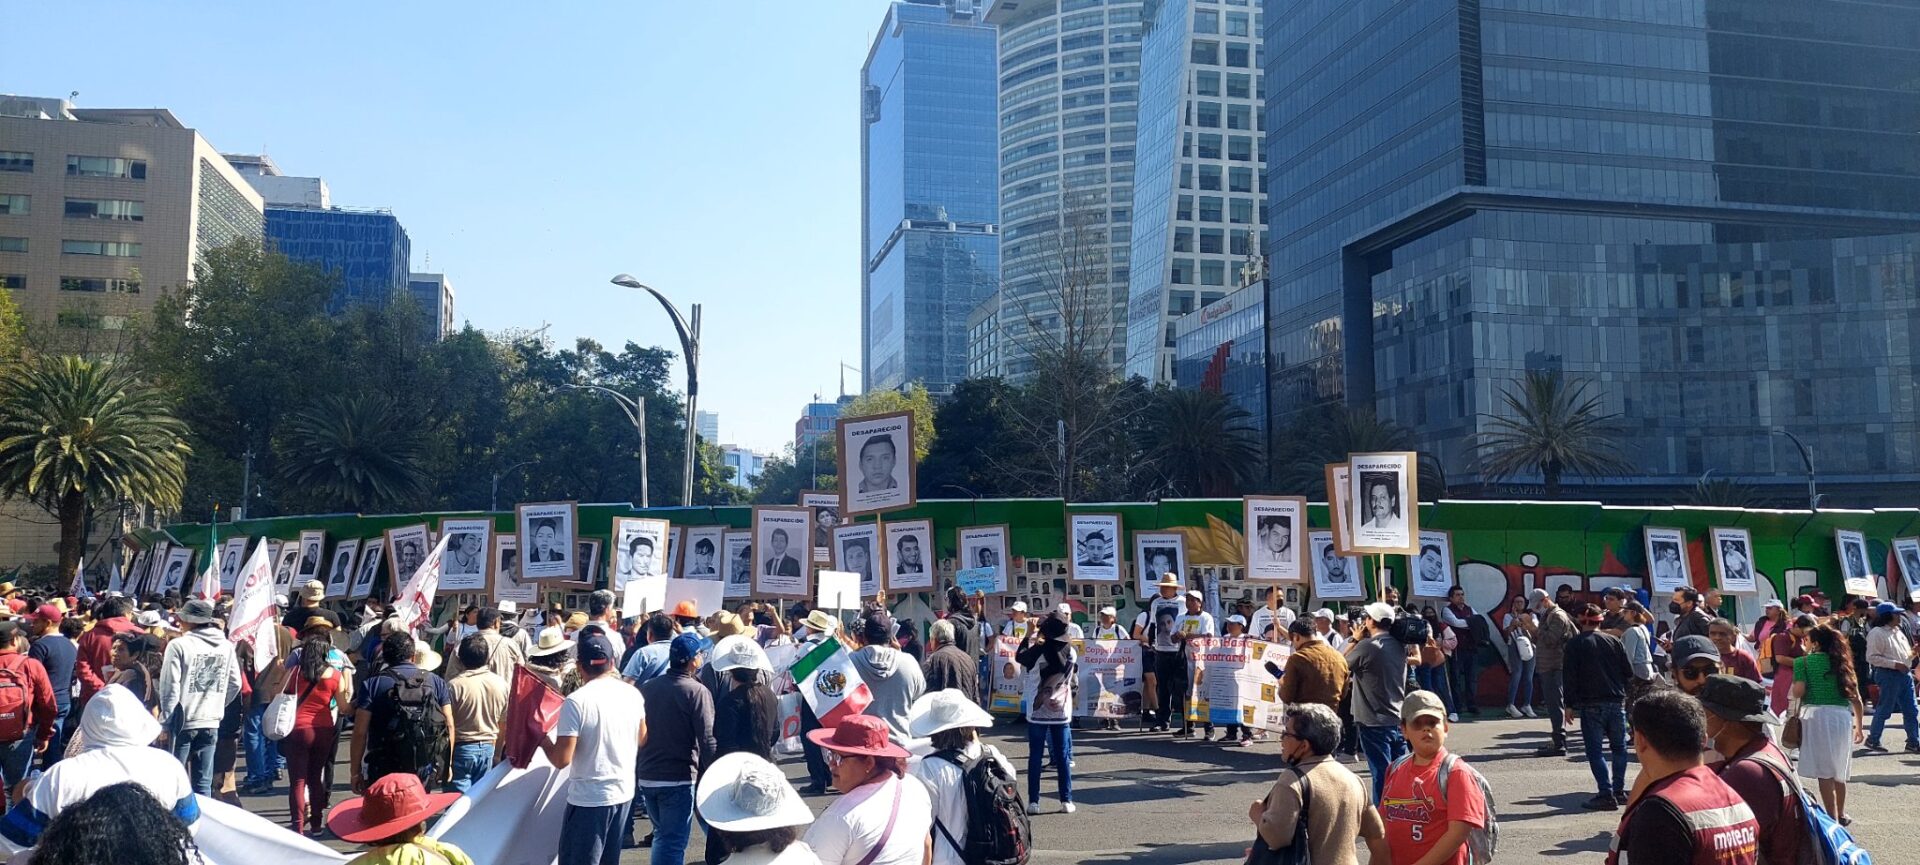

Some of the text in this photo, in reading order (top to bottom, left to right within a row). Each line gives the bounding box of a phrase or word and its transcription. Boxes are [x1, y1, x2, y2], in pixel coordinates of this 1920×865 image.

[852, 426, 902, 437] DESAPARECIDO
[1509, 486, 1546, 494] CAPITA
[1086, 646, 1112, 655] Coppel
[1085, 656, 1135, 664] Responsable
[1412, 824, 1423, 841] 5
[1713, 826, 1755, 850] morena
